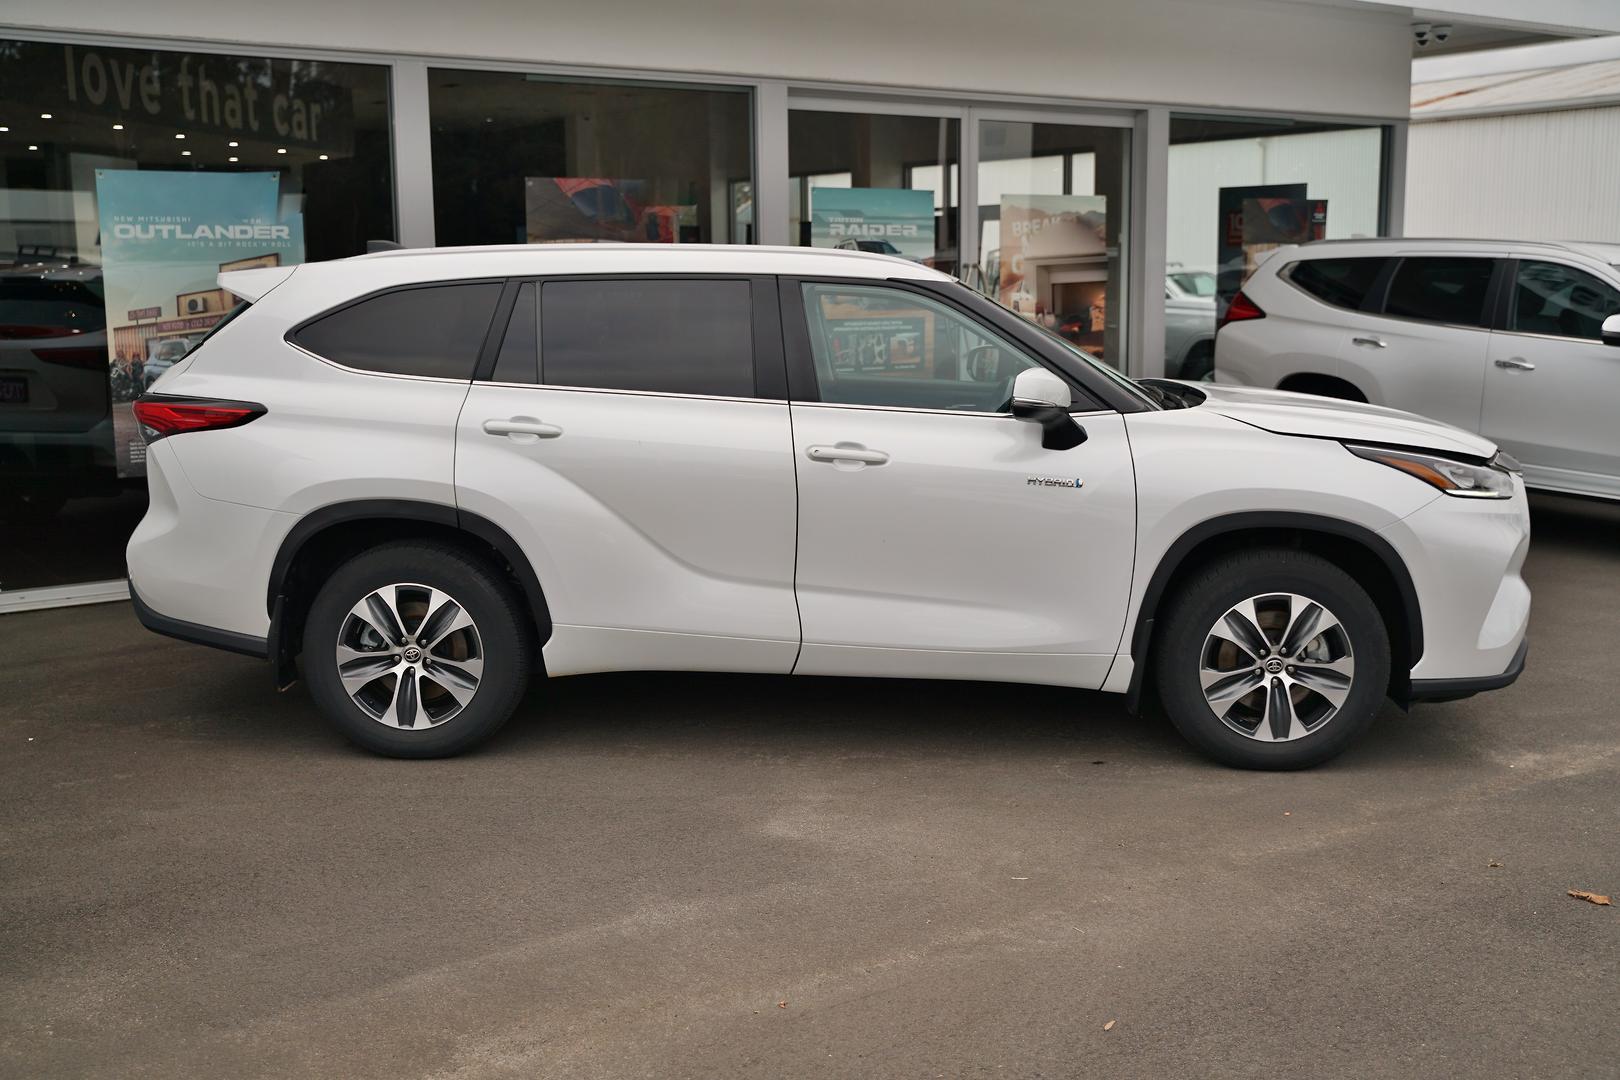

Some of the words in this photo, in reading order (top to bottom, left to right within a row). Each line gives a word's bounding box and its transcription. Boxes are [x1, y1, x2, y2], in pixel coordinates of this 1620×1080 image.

[64, 45, 161, 115] love
[177, 55, 260, 132] that
[272, 93, 321, 142] car
[113, 215, 134, 223] NEW
[137, 215, 191, 223] MITSUBISHI
[113, 223, 291, 240] OUTLANDER
[829, 223, 918, 237] RAIDER
[1026, 476, 1075, 488] HYBRID
